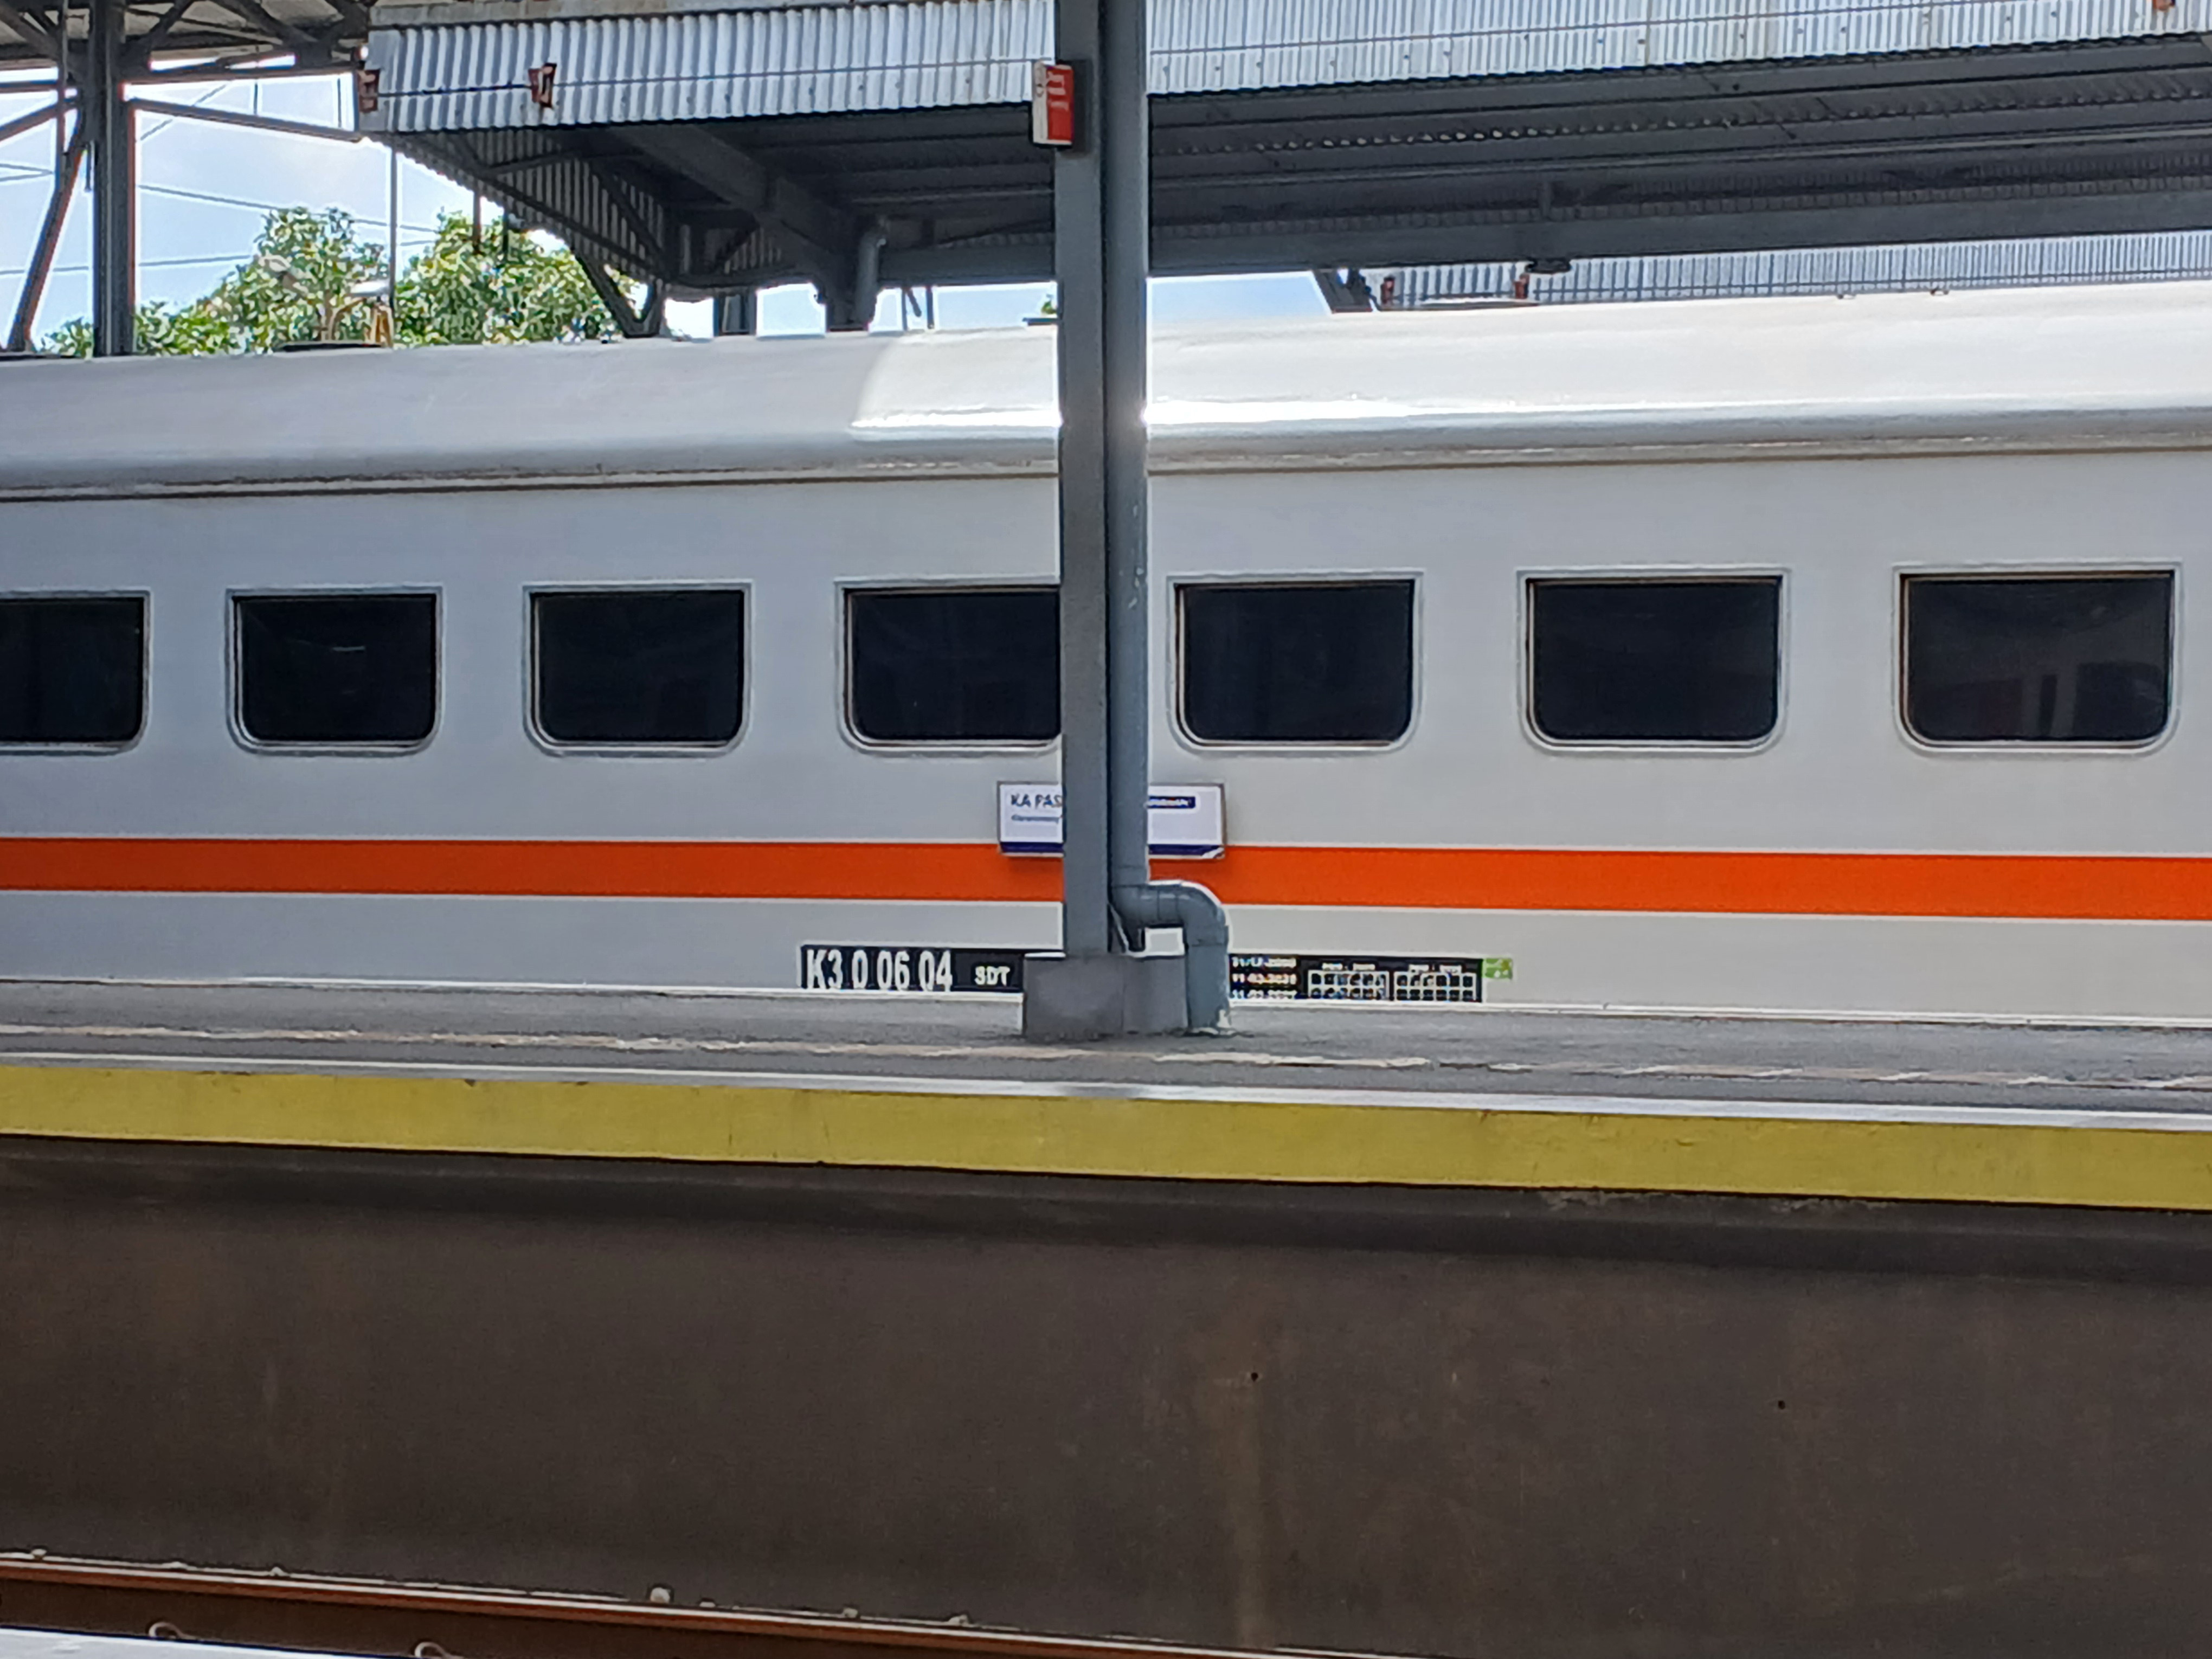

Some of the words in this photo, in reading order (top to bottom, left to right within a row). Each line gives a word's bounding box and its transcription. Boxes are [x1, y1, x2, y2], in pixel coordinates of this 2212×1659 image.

[1011, 793, 1031, 808] KA
[807, 949, 843, 990] K3
[852, 950, 867, 990] 0
[877, 950, 910, 991] 06
[918, 950, 953, 992] 04
[974, 966, 1011, 986] SDT
